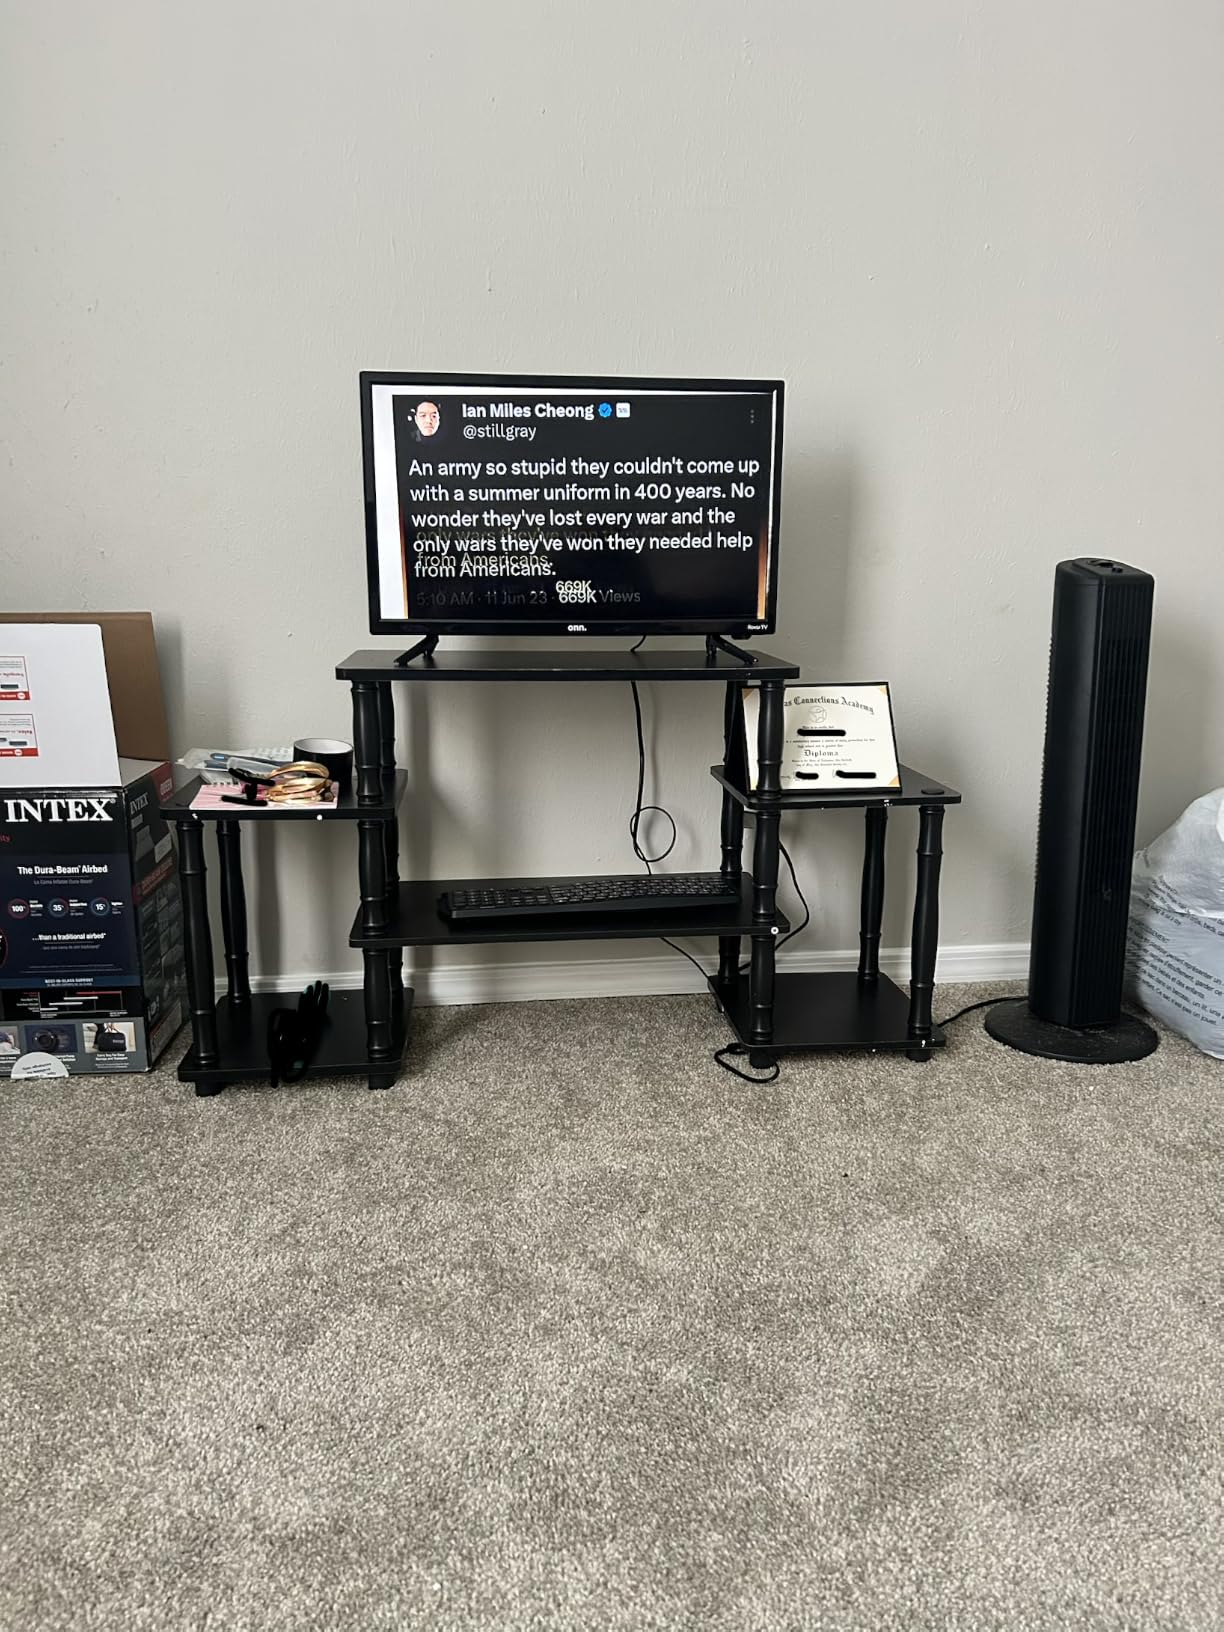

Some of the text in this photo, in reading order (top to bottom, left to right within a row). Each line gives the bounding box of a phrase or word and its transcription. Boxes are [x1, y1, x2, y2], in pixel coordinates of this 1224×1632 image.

[462, 403, 595, 420] Ian Miles Cheong
[463, 423, 537, 441] @stillgray
[409, 456, 760, 480] An army so stupid they couldn't come up
[410, 482, 755, 503] with a summer uniform in 400 years. No
[411, 507, 736, 530] wonder they've lost every war and the
[413, 536, 450, 556] only
[454, 539, 497, 552] wars
[500, 534, 563, 555] they've
[566, 538, 603, 551] won
[607, 533, 646, 554] they
[649, 531, 712, 549] needed
[716, 530, 753, 551] help
[414, 560, 557, 578] from Americans.
[417, 589, 641, 606] 5:10 AM 11 Jun 23 669K Views
[804, 749, 839, 757] Diploma
[4, 798, 113, 822] INTEX
[17, 866, 33, 875] The
[82, 865, 108, 873] Airbed
